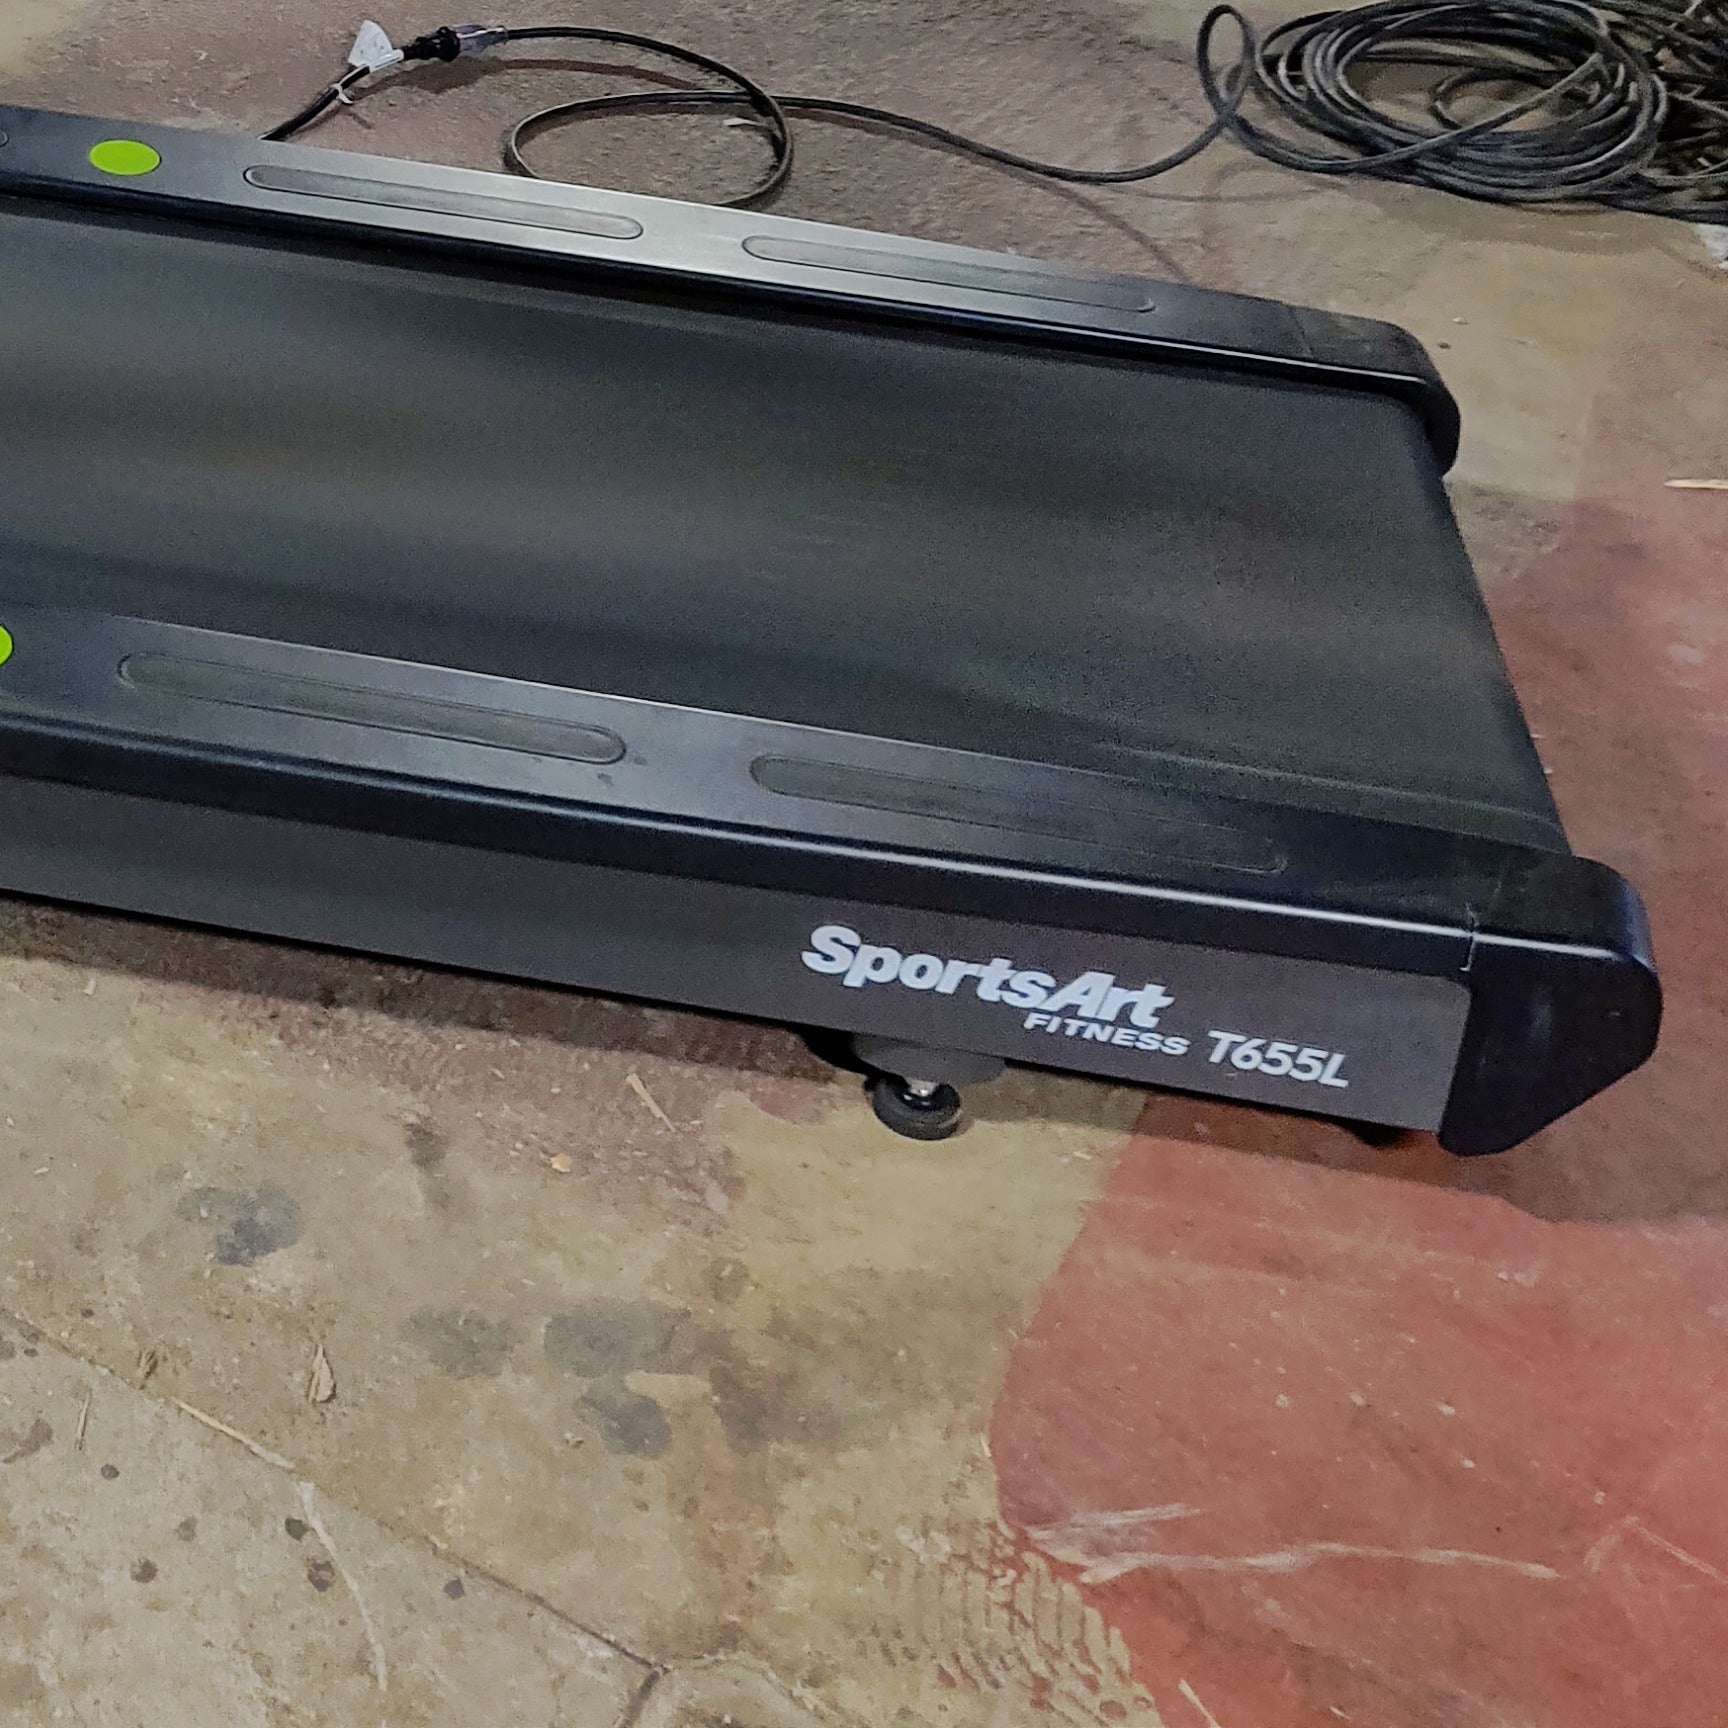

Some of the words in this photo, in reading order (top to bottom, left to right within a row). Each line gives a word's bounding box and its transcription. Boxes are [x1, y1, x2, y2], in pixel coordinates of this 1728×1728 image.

[800, 924, 1175, 1029] SportsArt
[1023, 1012, 1191, 1056] FITNESS
[1207, 1029, 1350, 1089] T655L
